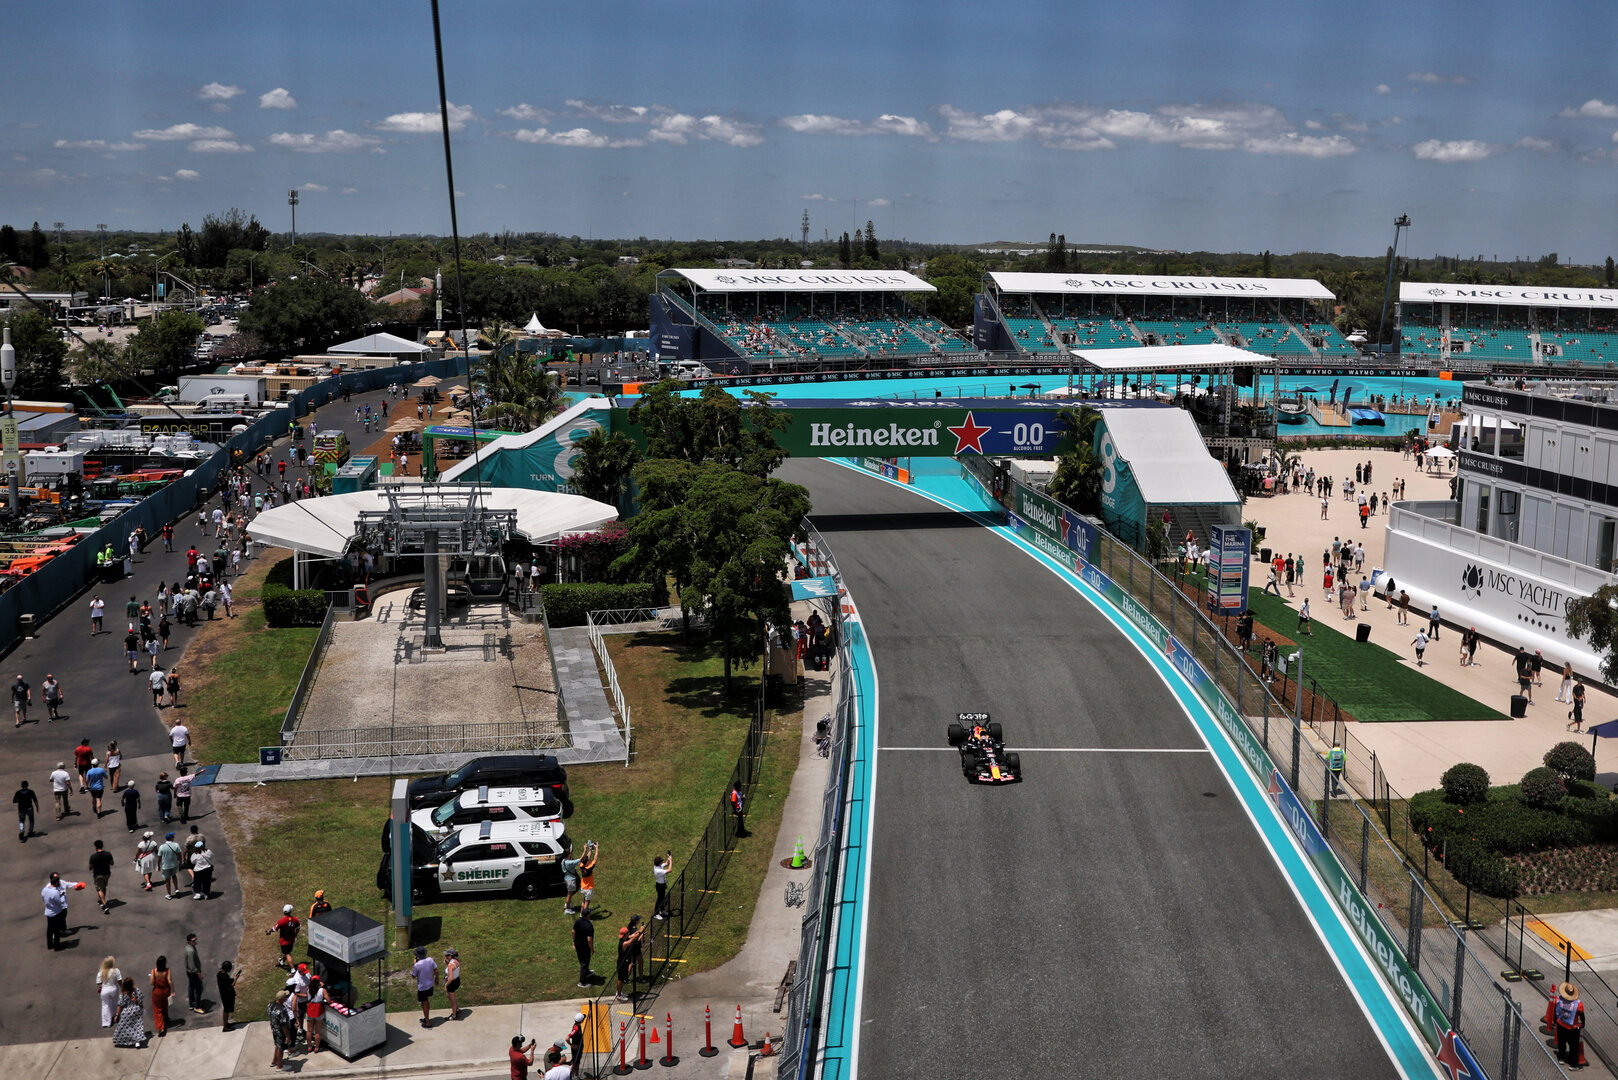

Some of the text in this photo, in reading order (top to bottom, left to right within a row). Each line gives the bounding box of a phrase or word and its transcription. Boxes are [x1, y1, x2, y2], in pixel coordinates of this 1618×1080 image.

[740, 276, 906, 284] MSC CRUISES
[1090, 279, 1268, 292] MSC CRUISES
[1456, 288, 1614, 302] MSC CRUIS
[1468, 392, 1508, 406] MSC CRUISES
[1013, 423, 1043, 445] 0.0
[1101, 432, 1117, 493] 8
[1464, 456, 1504, 473] MSC CRUISES
[1035, 531, 1071, 565] Heineken
[1488, 570, 1515, 596] MSC
[1519, 580, 1562, 611] YACHT
[1122, 595, 1162, 643] Heineken
[1218, 697, 1263, 772] Heineken
[1292, 809, 1307, 841] 0.0
[458, 869, 509, 880] SHERIFF
